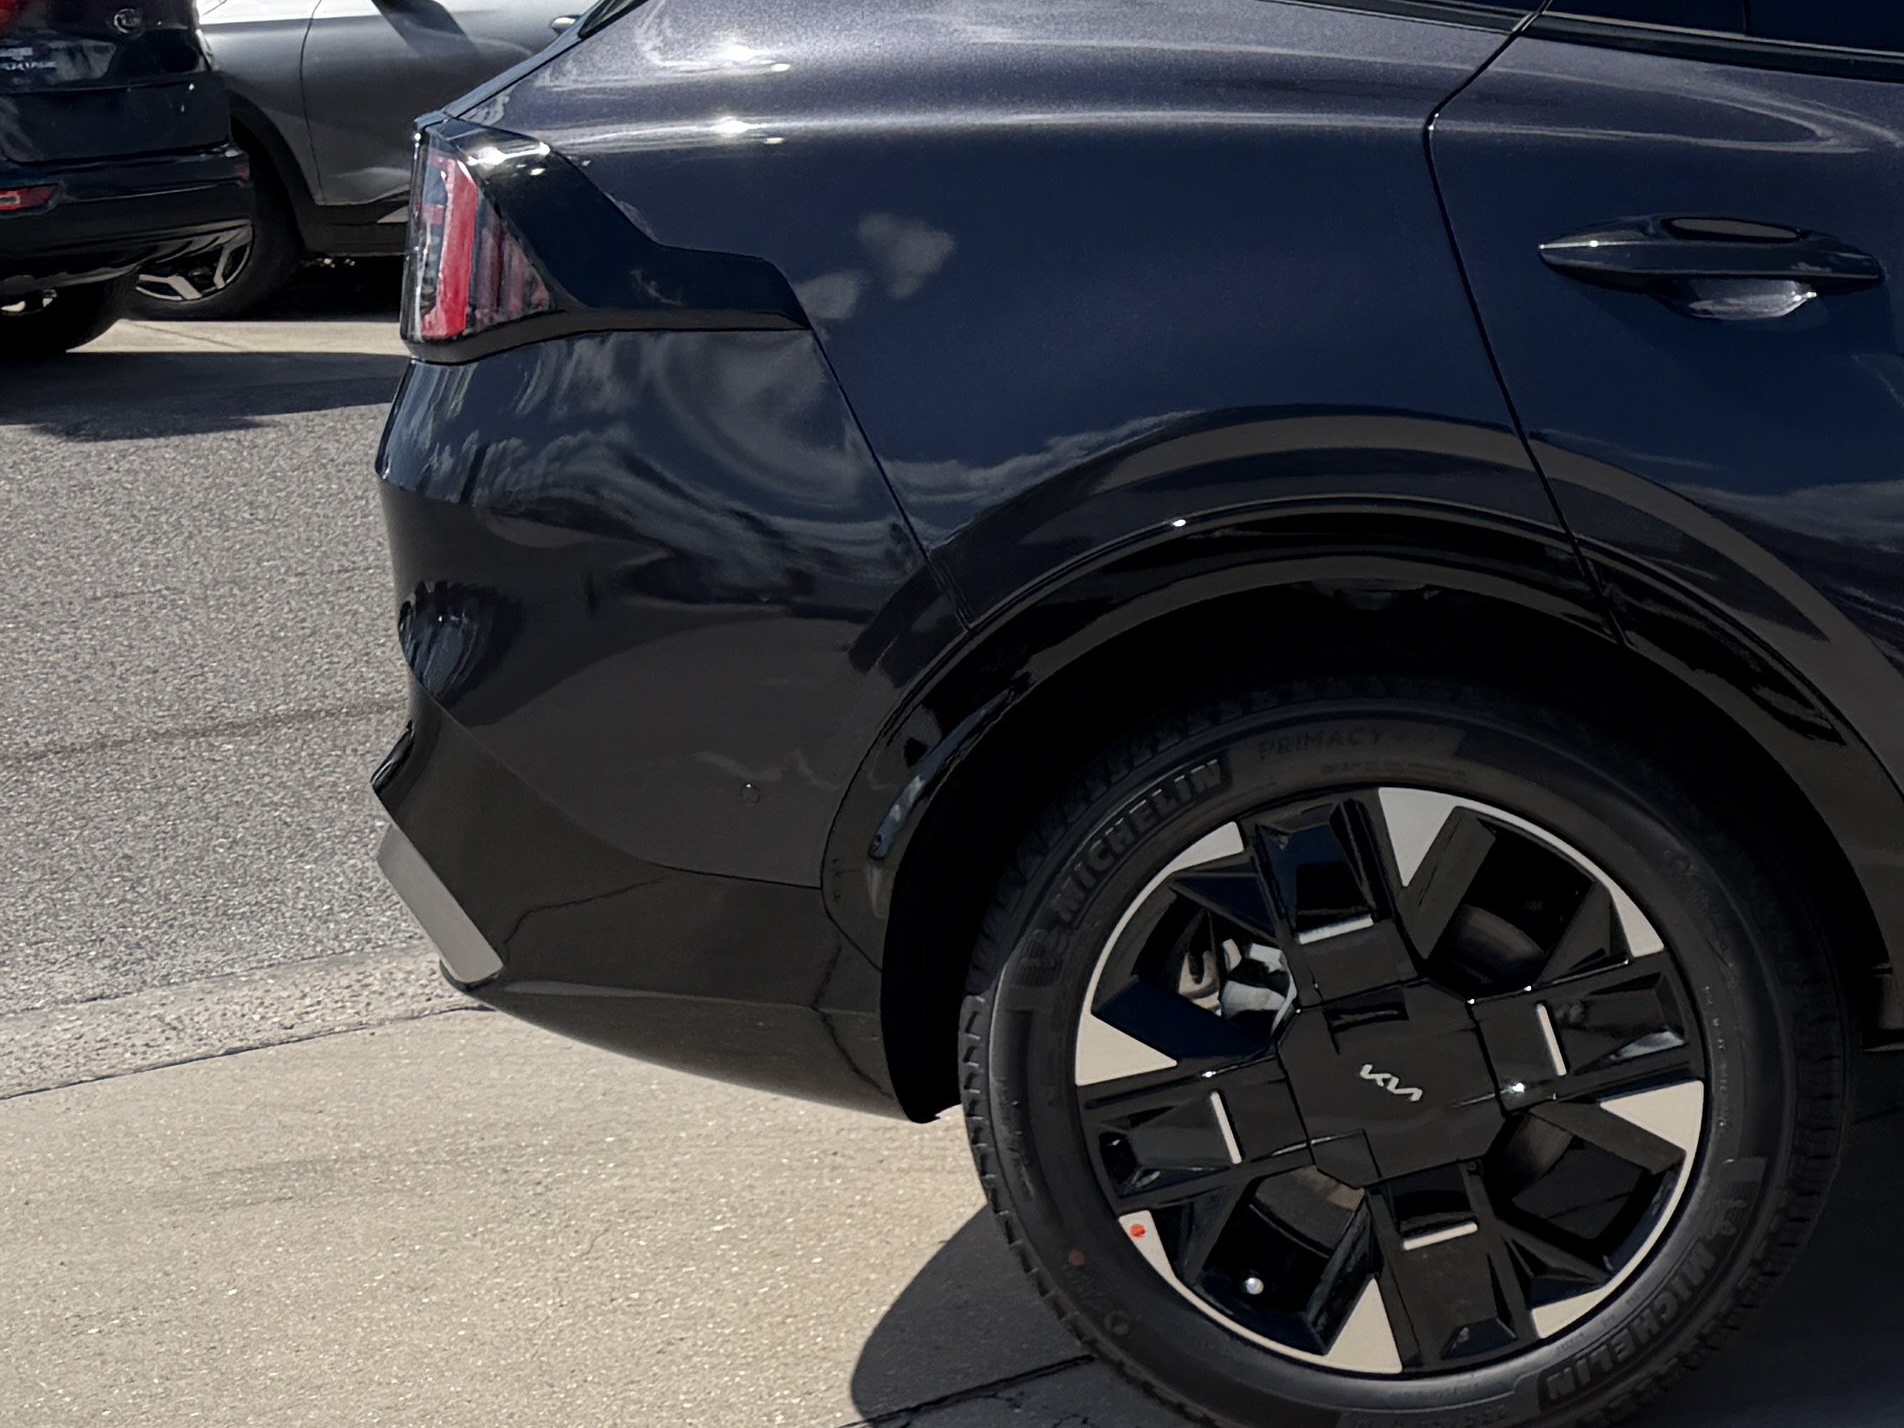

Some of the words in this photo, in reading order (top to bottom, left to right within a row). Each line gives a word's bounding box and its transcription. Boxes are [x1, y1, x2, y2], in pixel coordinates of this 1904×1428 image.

[1056, 757, 1225, 918] MICHELIN
[1360, 1064, 1423, 1102] KIA
[1544, 1241, 1717, 1401] MICHELIN
